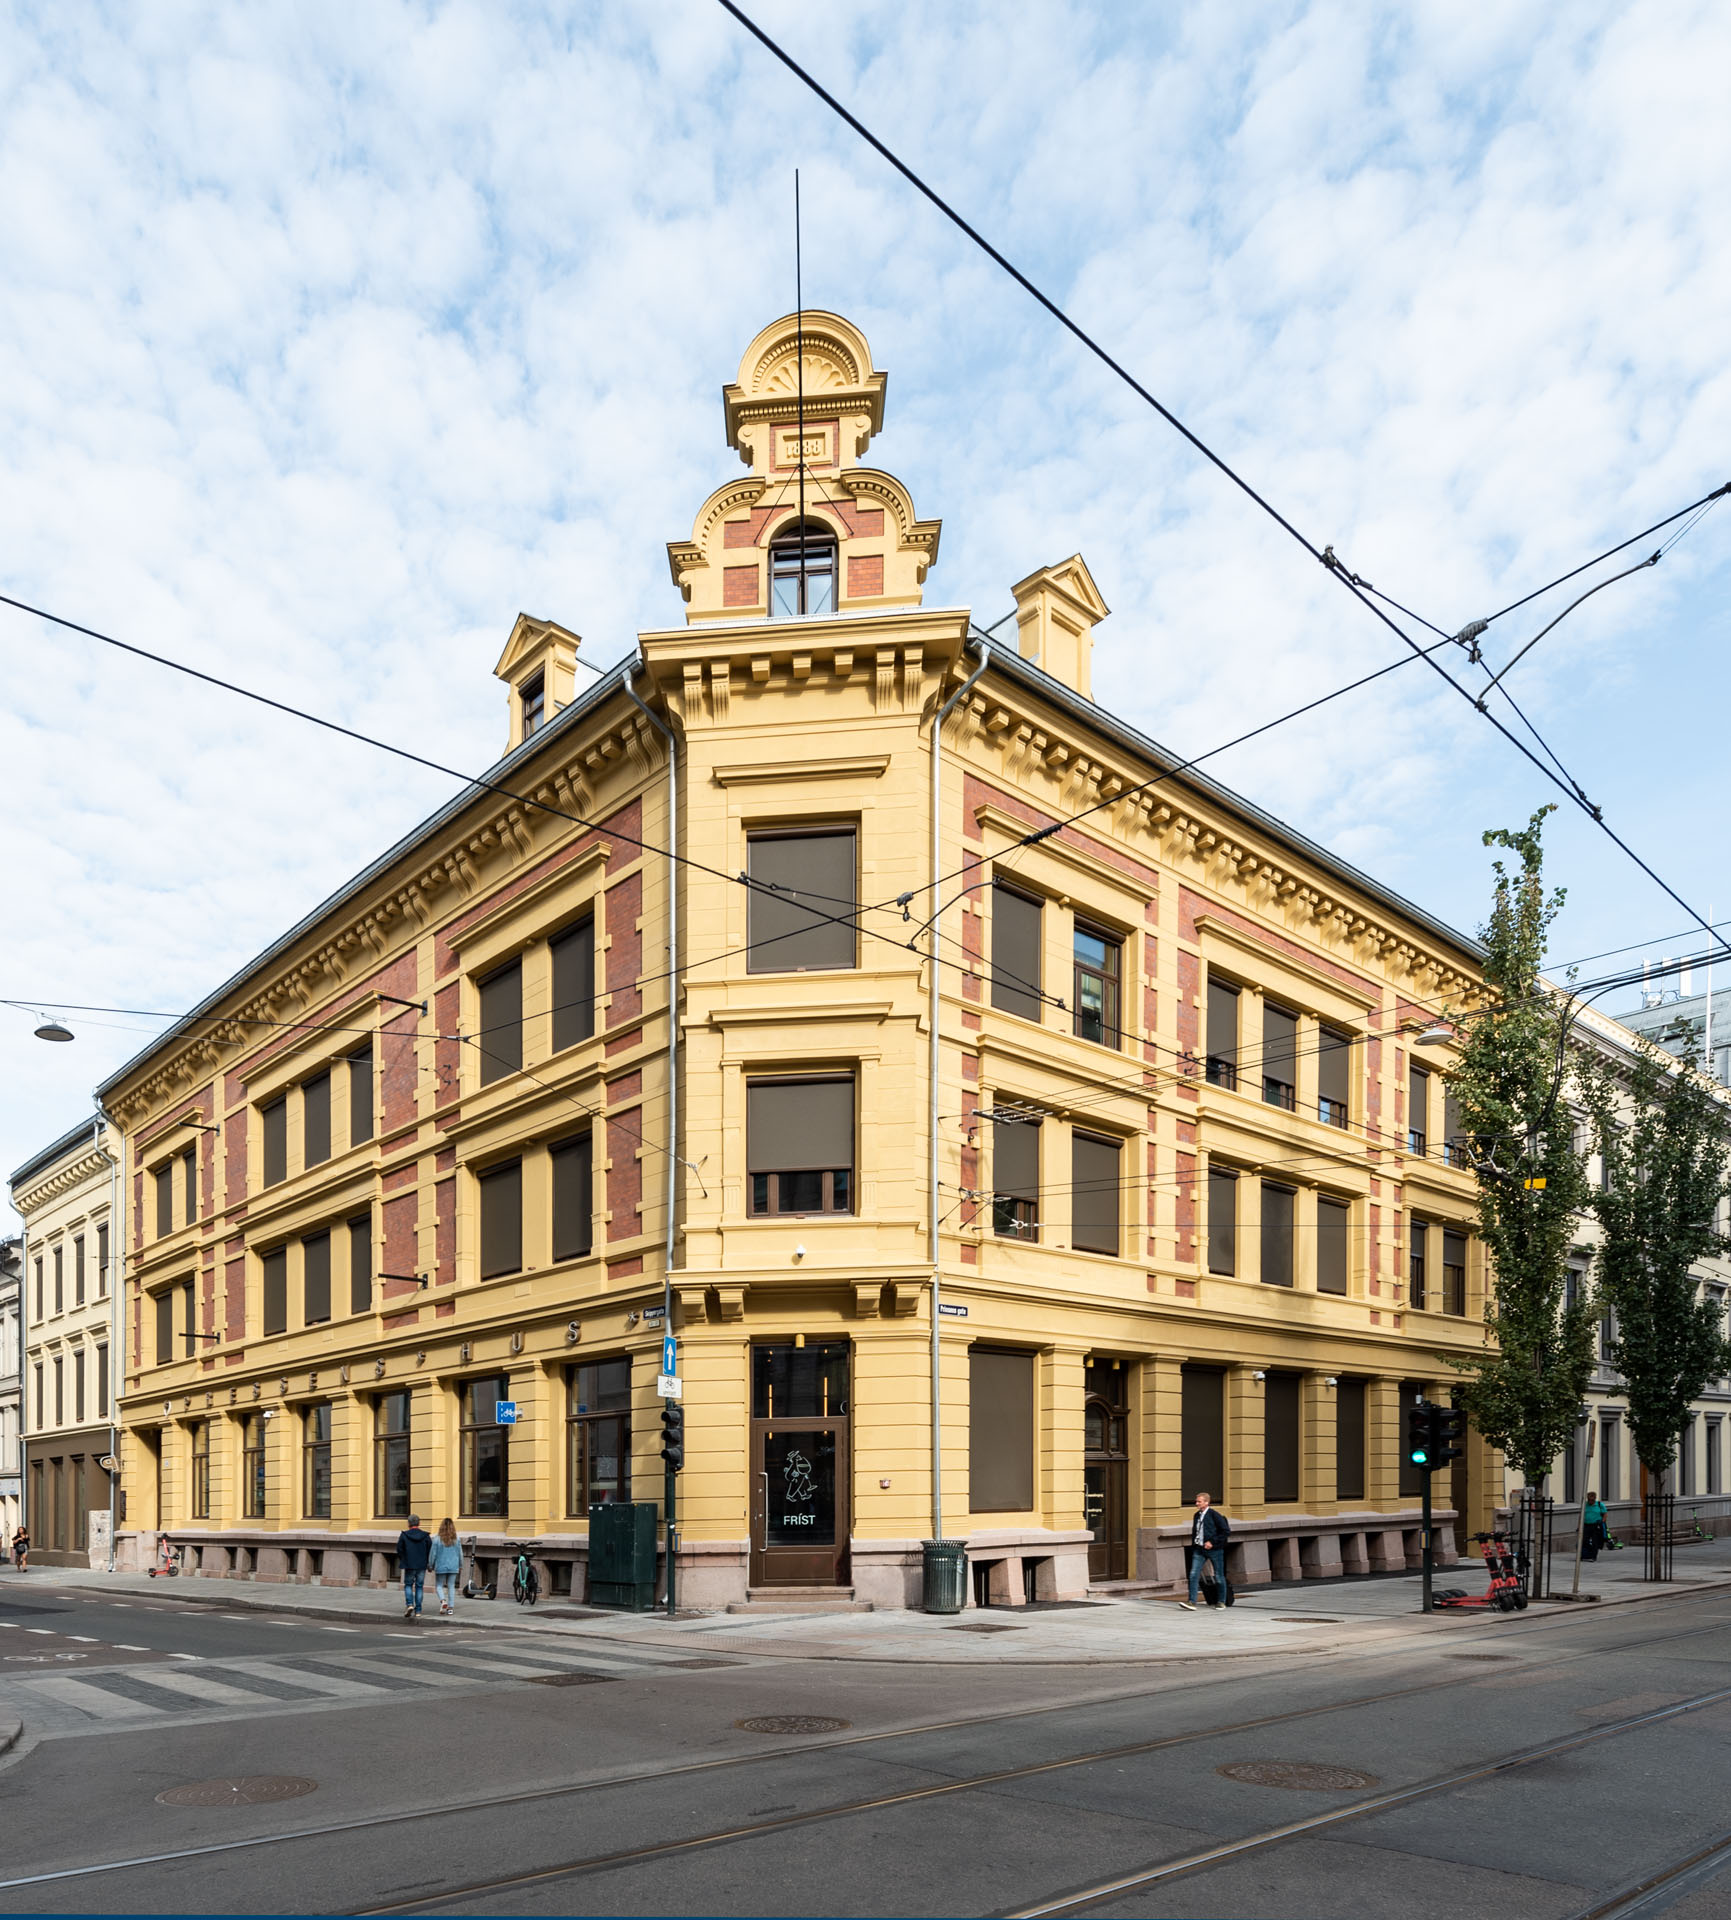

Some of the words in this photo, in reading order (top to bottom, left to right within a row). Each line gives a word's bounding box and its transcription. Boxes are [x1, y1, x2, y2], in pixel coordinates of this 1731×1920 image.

[183, 1357, 387, 1410] PRESSENS
[461, 1319, 581, 1362] HUS
[783, 1512, 816, 1526] FRÍST
